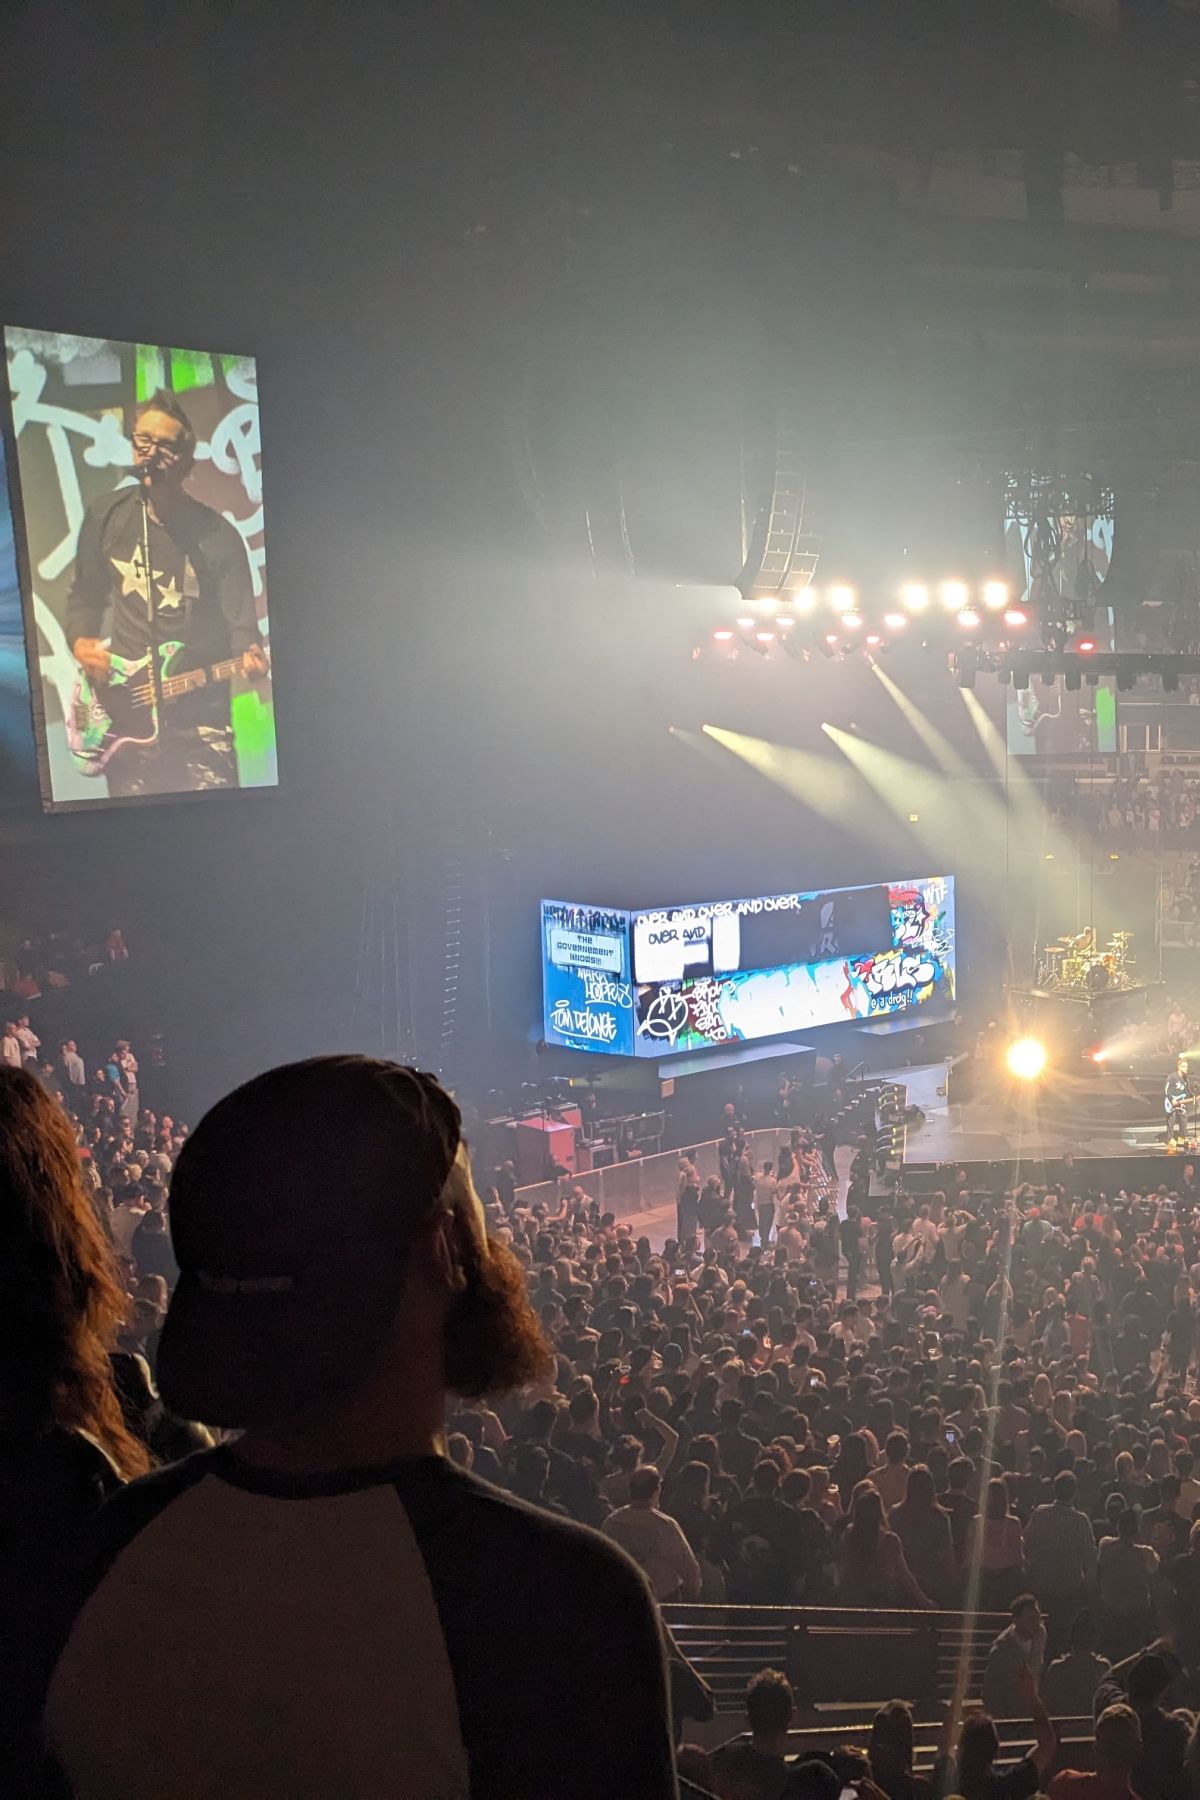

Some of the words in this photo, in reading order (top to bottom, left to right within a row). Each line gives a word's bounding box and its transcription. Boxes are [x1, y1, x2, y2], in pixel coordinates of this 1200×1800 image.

[923, 884, 948, 905] WTF
[636, 911, 669, 928] OVER
[672, 908, 696, 925] AND
[698, 902, 734, 919] OVER
[736, 899, 763, 916] AND
[764, 895, 801, 911] OVER
[577, 935, 593, 945] THE
[648, 929, 680, 945] OVER
[682, 925, 707, 940] AND
[550, 1008, 574, 1031] TOM
